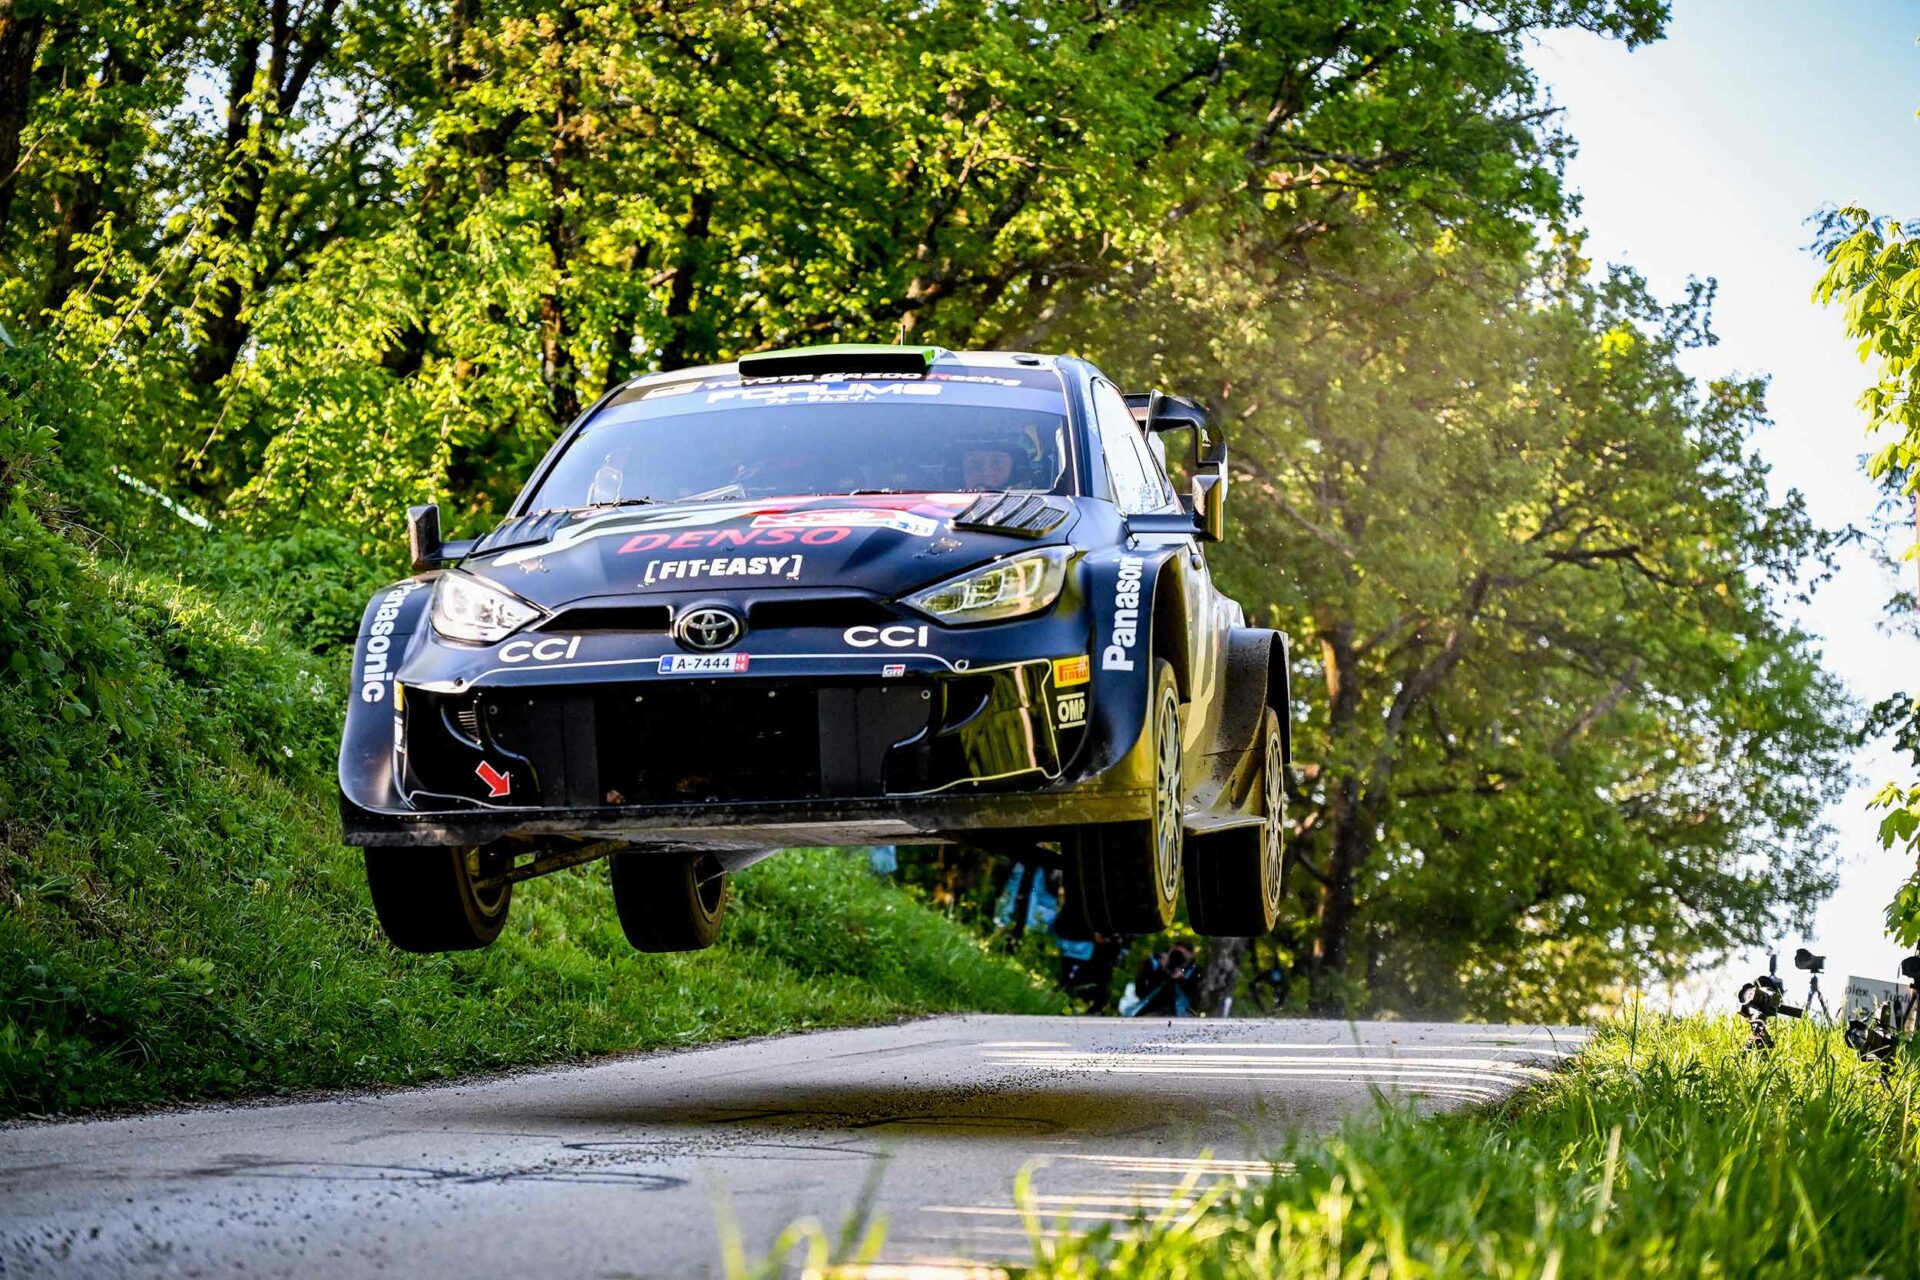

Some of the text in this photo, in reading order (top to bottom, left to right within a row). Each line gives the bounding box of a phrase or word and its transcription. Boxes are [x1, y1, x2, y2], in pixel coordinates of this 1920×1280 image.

[705, 374, 813, 390] TOYOTA
[815, 372, 922, 384] GAZOO
[925, 373, 1022, 387] Racing
[617, 527, 852, 554] DENSO
[361, 582, 427, 703] Panasonic
[843, 625, 928, 648] CCI
[498, 636, 582, 663] CCI
[676, 657, 730, 670] A-7444
[1058, 698, 1086, 723] OMP
